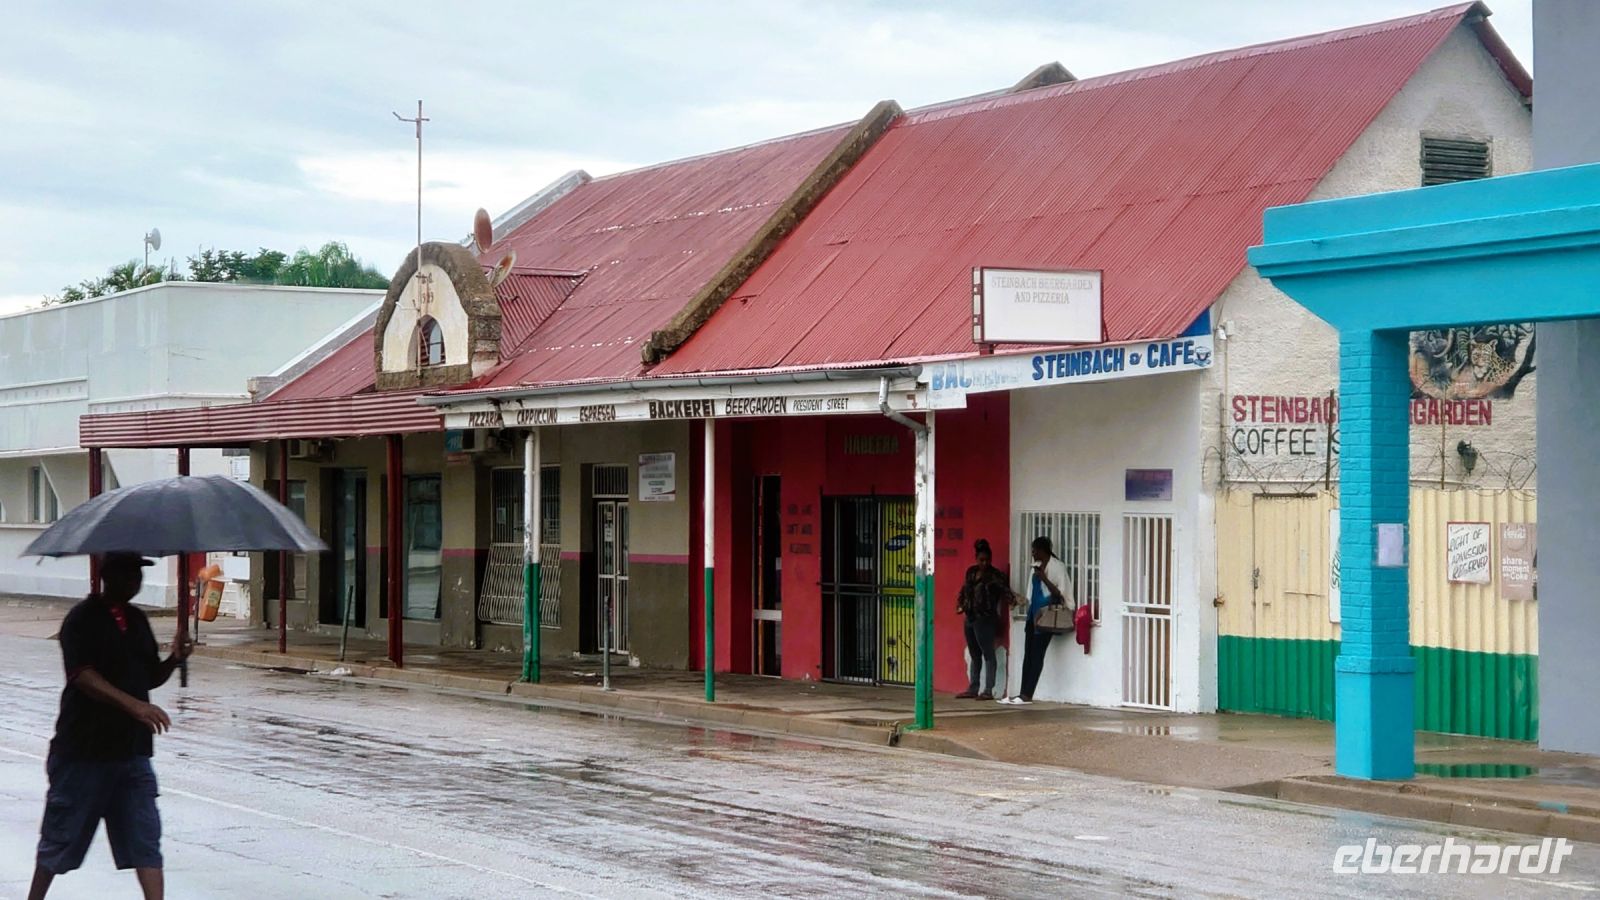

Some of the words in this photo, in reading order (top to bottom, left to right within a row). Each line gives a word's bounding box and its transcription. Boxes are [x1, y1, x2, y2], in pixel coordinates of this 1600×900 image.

[992, 276, 1036, 289] STEINBACH
[1039, 277, 1093, 290] BEERGARDEN
[1014, 291, 1030, 303] AND
[1033, 292, 1070, 304] PIZZERIA
[1031, 347, 1125, 381] STEINBACH
[516, 407, 558, 425] CAPPUCCINO
[579, 404, 617, 422] ESPRESSO
[725, 396, 787, 415] BEERGARDEN
[793, 399, 823, 412] PRESIDENT
[827, 397, 849, 411] STREET
[1231, 394, 1340, 424] STEINBAC
[1231, 427, 1317, 456] COFFEE
[1502, 556, 1523, 565] share
[1502, 565, 1530, 573] moment
